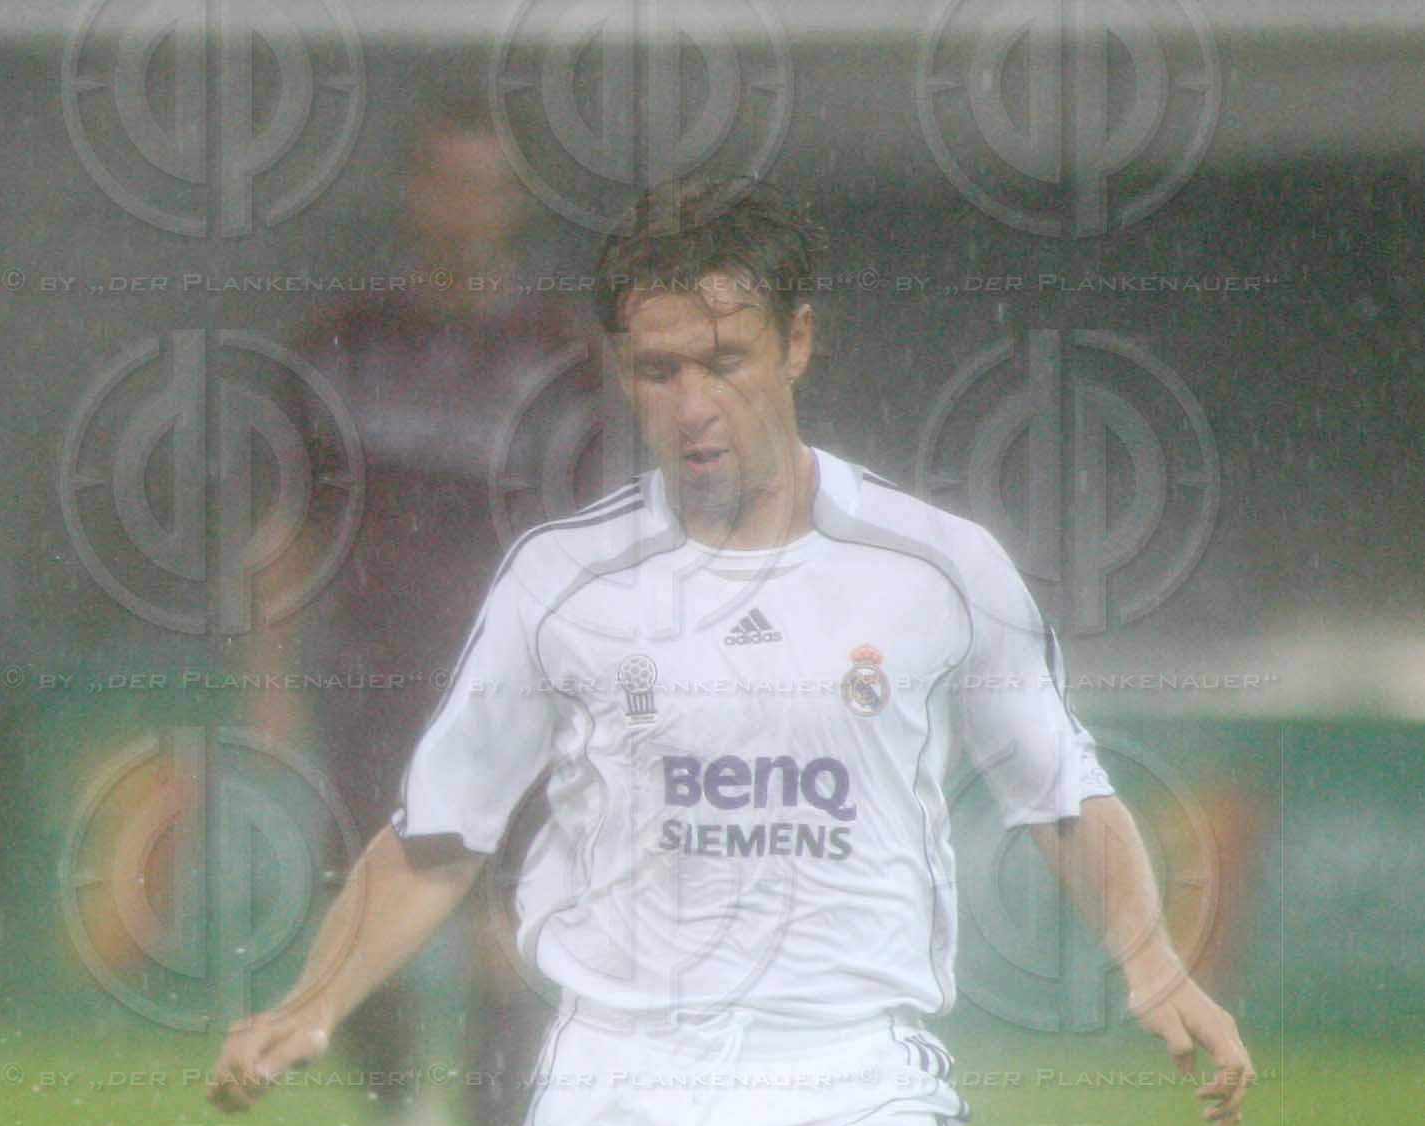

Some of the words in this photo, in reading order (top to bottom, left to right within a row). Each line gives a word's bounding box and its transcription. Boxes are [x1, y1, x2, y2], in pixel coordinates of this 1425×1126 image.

[724, 630, 782, 646] adidas
[662, 755, 857, 821] BenQ
[659, 819, 853, 860] SIEMENS
